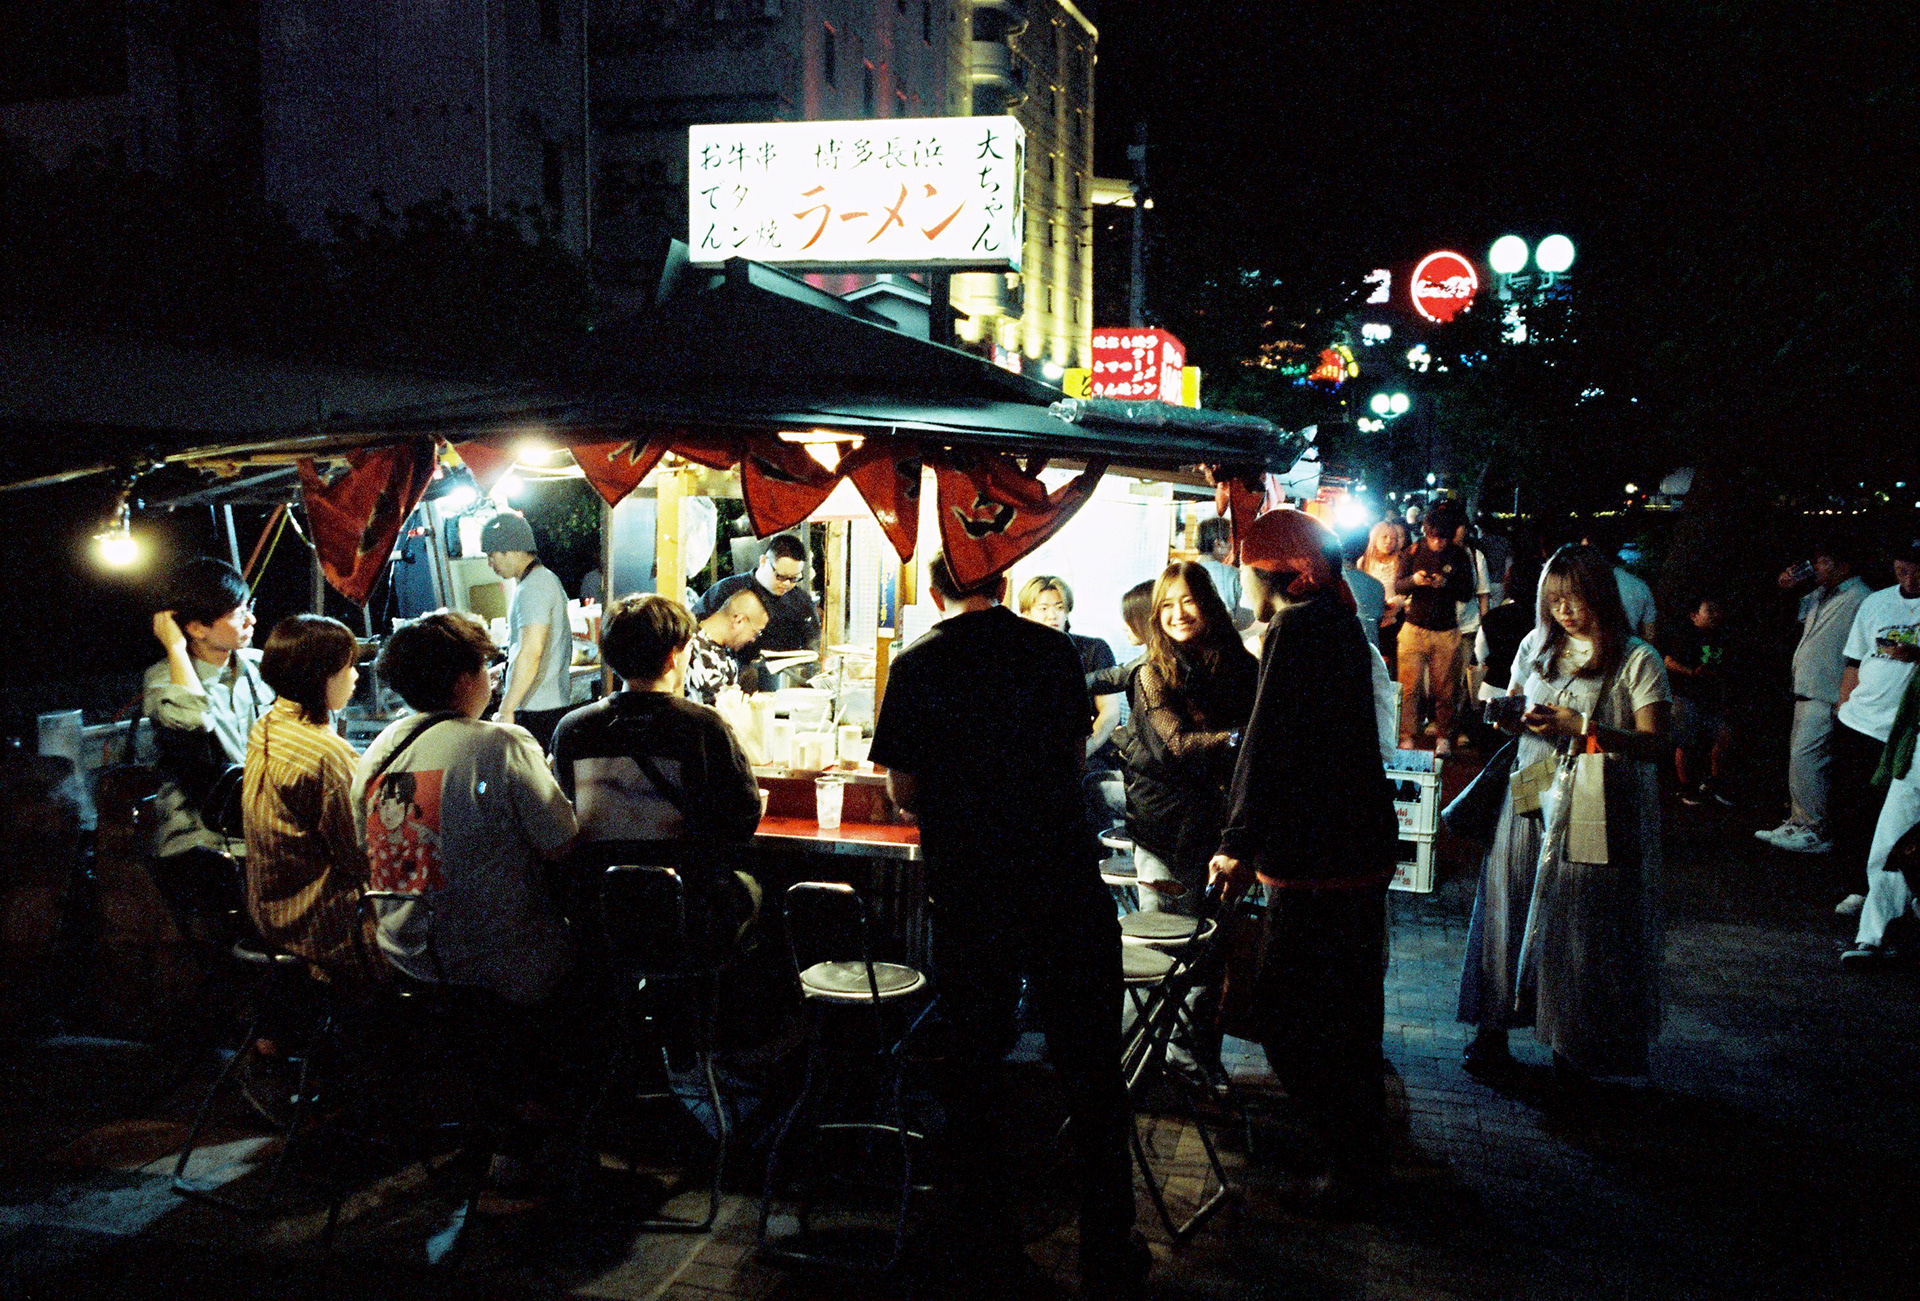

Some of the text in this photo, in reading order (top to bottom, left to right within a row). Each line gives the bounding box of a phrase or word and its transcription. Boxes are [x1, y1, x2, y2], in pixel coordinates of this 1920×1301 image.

[701, 142, 723, 249] おでん
[728, 141, 751, 248] 牛タン
[813, 136, 944, 170] 博多長浜
[971, 128, 1004, 251] 大ちゃん
[793, 183, 966, 250] ラーメン
